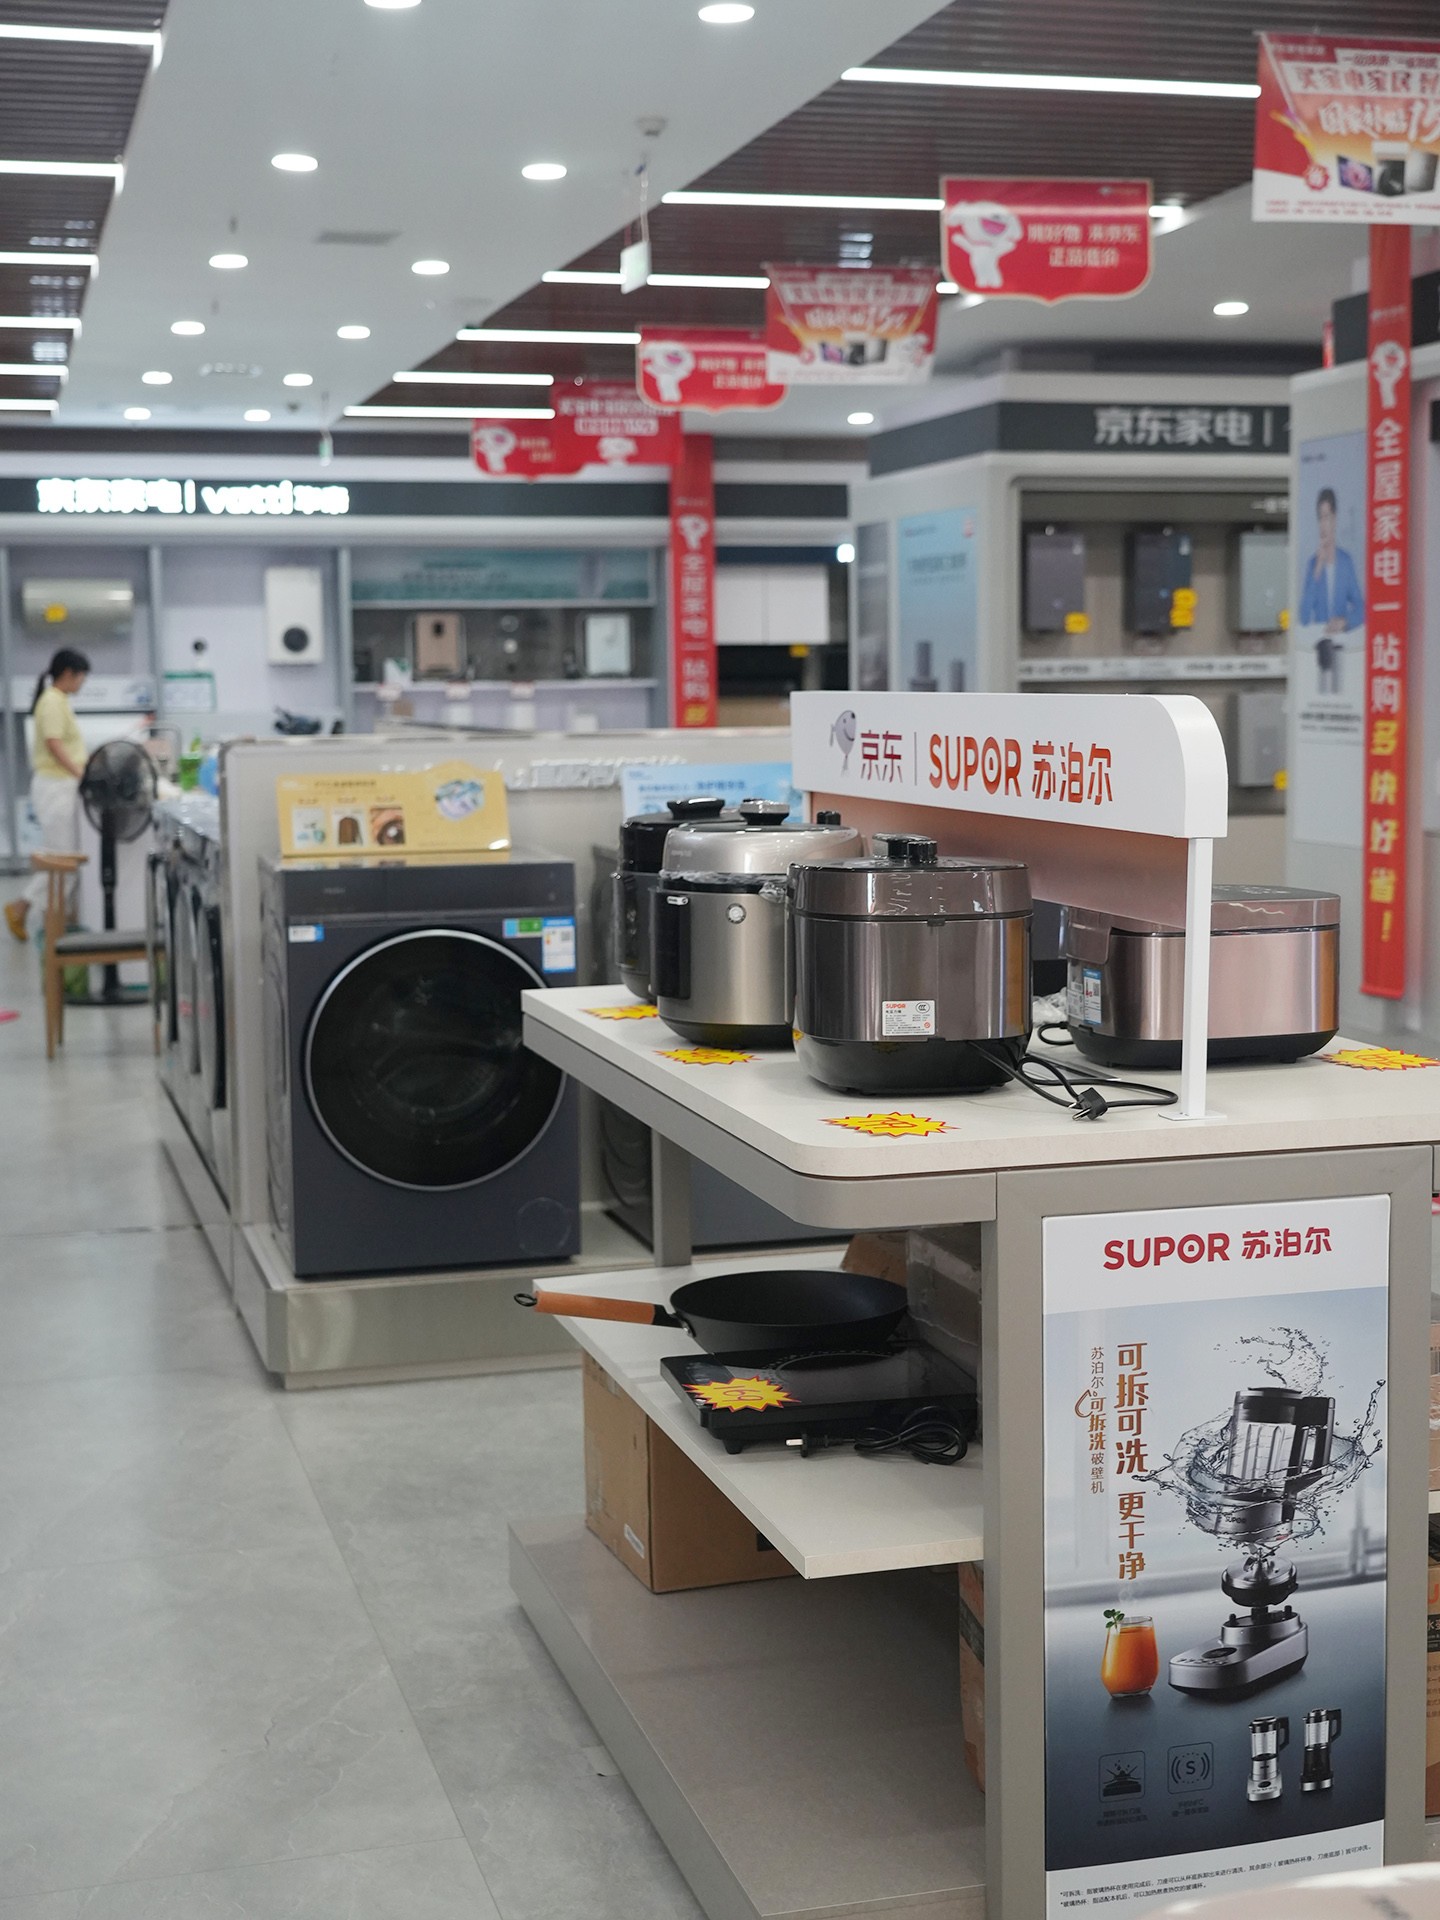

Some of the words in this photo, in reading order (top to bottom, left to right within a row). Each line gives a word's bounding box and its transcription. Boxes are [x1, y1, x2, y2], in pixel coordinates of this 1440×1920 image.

[1094, 406, 1253, 447] 京东家电
[860, 730, 903, 784] 京东
[929, 733, 1022, 797] SUPOR
[1032, 740, 1113, 806] 苏泊尔
[1103, 1232, 1231, 1270] SUPOR
[1241, 1226, 1333, 1260] 苏泊尔
[1113, 1342, 1149, 1476] 可拆可洗
[1118, 1491, 1147, 1581] 更干净
